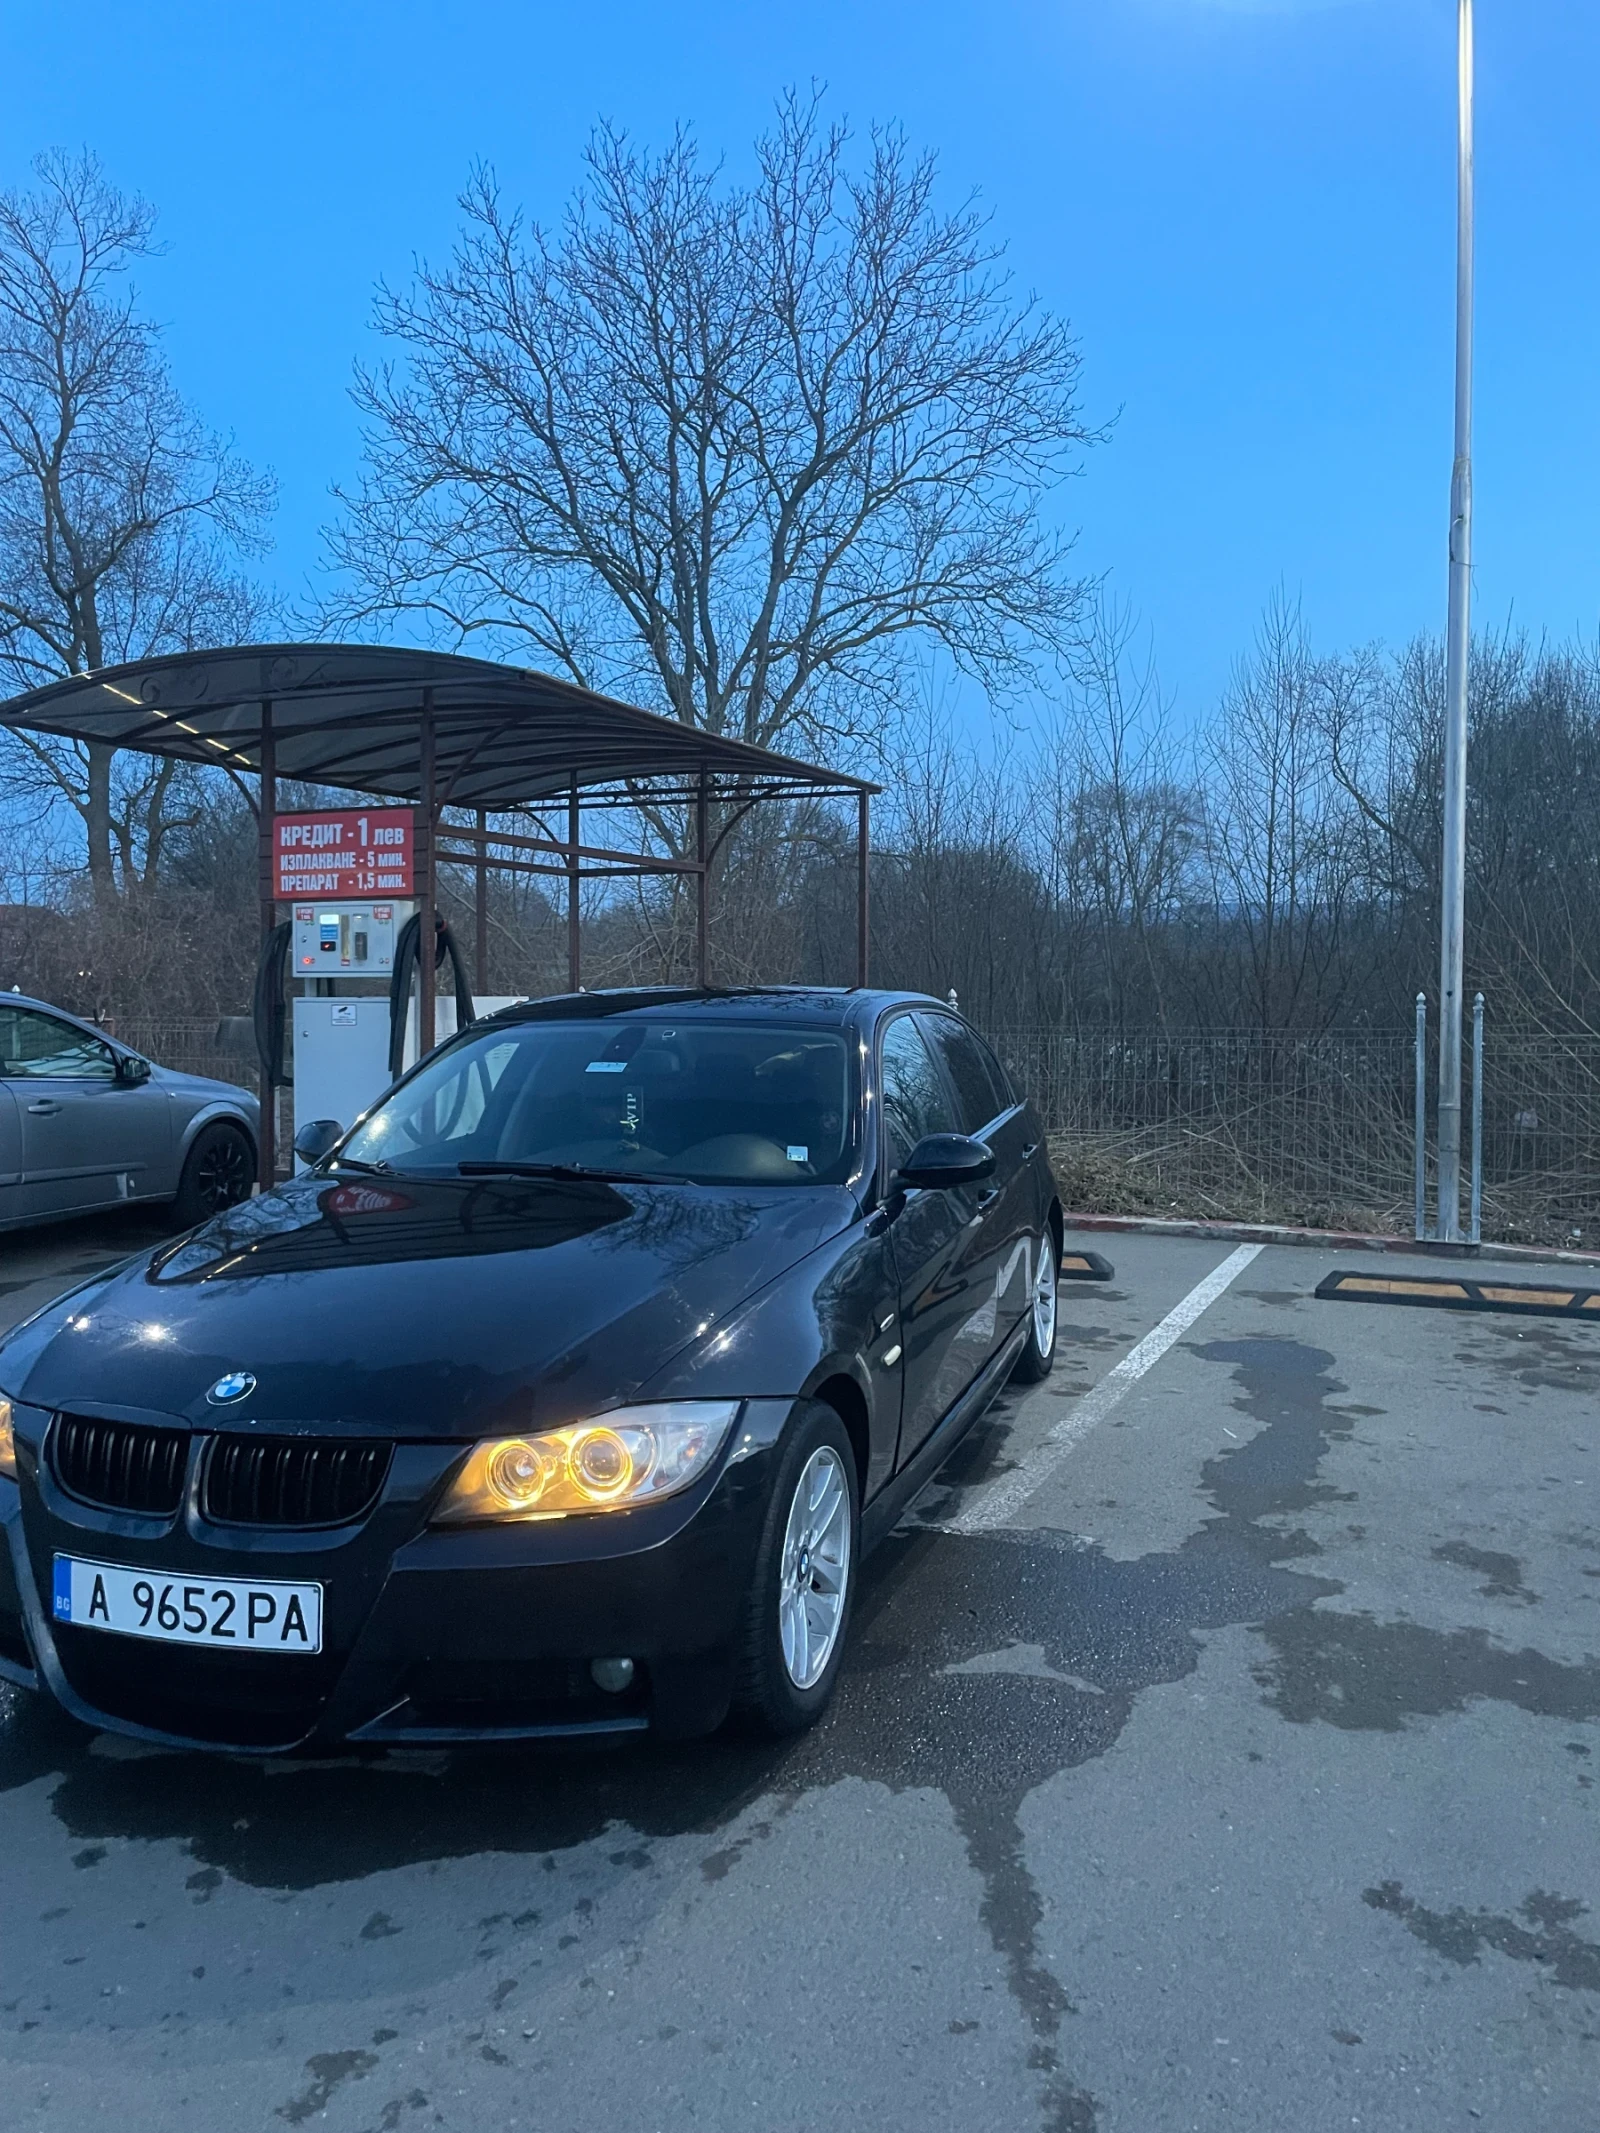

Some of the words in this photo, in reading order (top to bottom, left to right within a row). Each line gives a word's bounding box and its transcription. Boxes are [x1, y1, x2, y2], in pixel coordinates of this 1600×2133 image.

[281, 823, 343, 849] КРЕДИТ
[357, 817, 368, 847] 1
[373, 827, 405, 846] лев
[280, 851, 356, 871] ИЗПЛАКВАНЕ
[367, 851, 375, 867] 5
[281, 873, 339, 892] ПРЕПАРАТ
[357, 872, 375, 891] 1,5
[627, 1093, 637, 1121] VIP
[56, 1595, 71, 1612] BG
[89, 1573, 110, 1622] A
